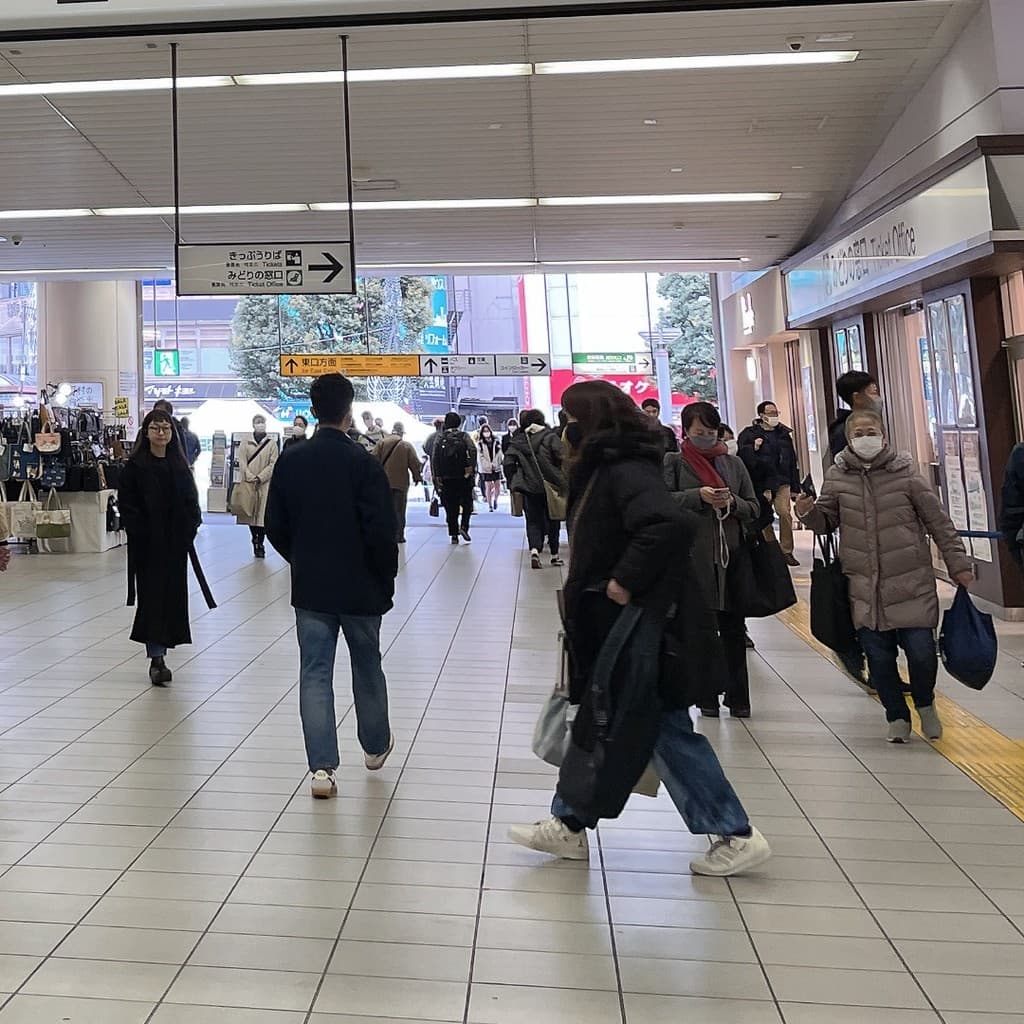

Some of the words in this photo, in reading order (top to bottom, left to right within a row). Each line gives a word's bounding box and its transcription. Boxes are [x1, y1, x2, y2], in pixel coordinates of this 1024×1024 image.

[892, 221, 917, 257] Office
[228, 249, 283, 261] きっぷうりば
[227, 270, 284, 281] みどりの窓口
